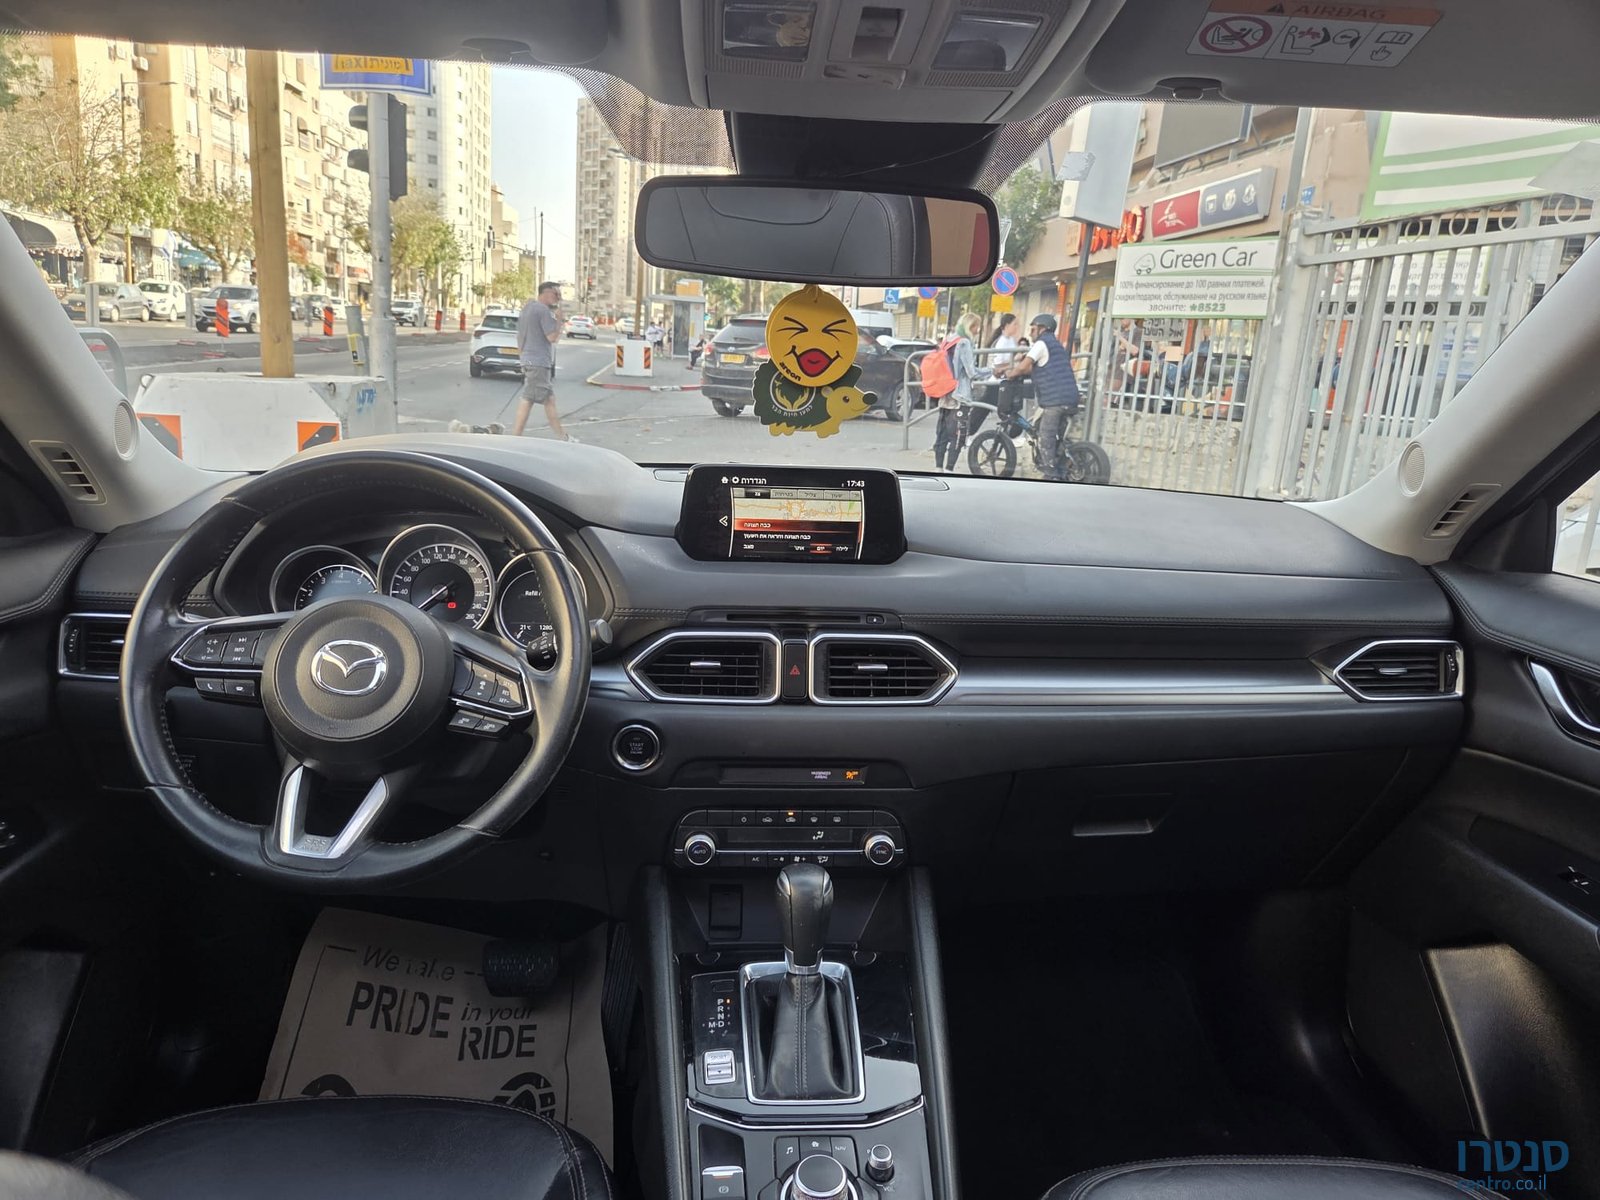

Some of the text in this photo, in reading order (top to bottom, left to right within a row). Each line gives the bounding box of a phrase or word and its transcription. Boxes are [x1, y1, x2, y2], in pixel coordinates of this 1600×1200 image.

[1294, 4, 1386, 20] AIRBAG
[1160, 246, 1258, 270] Green Car
[1120, 280, 1134, 289] 100%
[1196, 280, 1206, 288] 100
[1218, 292, 1246, 303] русском
[780, 361, 801, 382] areon
[800, 405, 813, 416] למען
[740, 477, 767, 485] הגדרות
[364, 944, 400, 970] We
[346, 980, 535, 1038] PRIDE in your
[458, 1024, 537, 1061] RIDE
